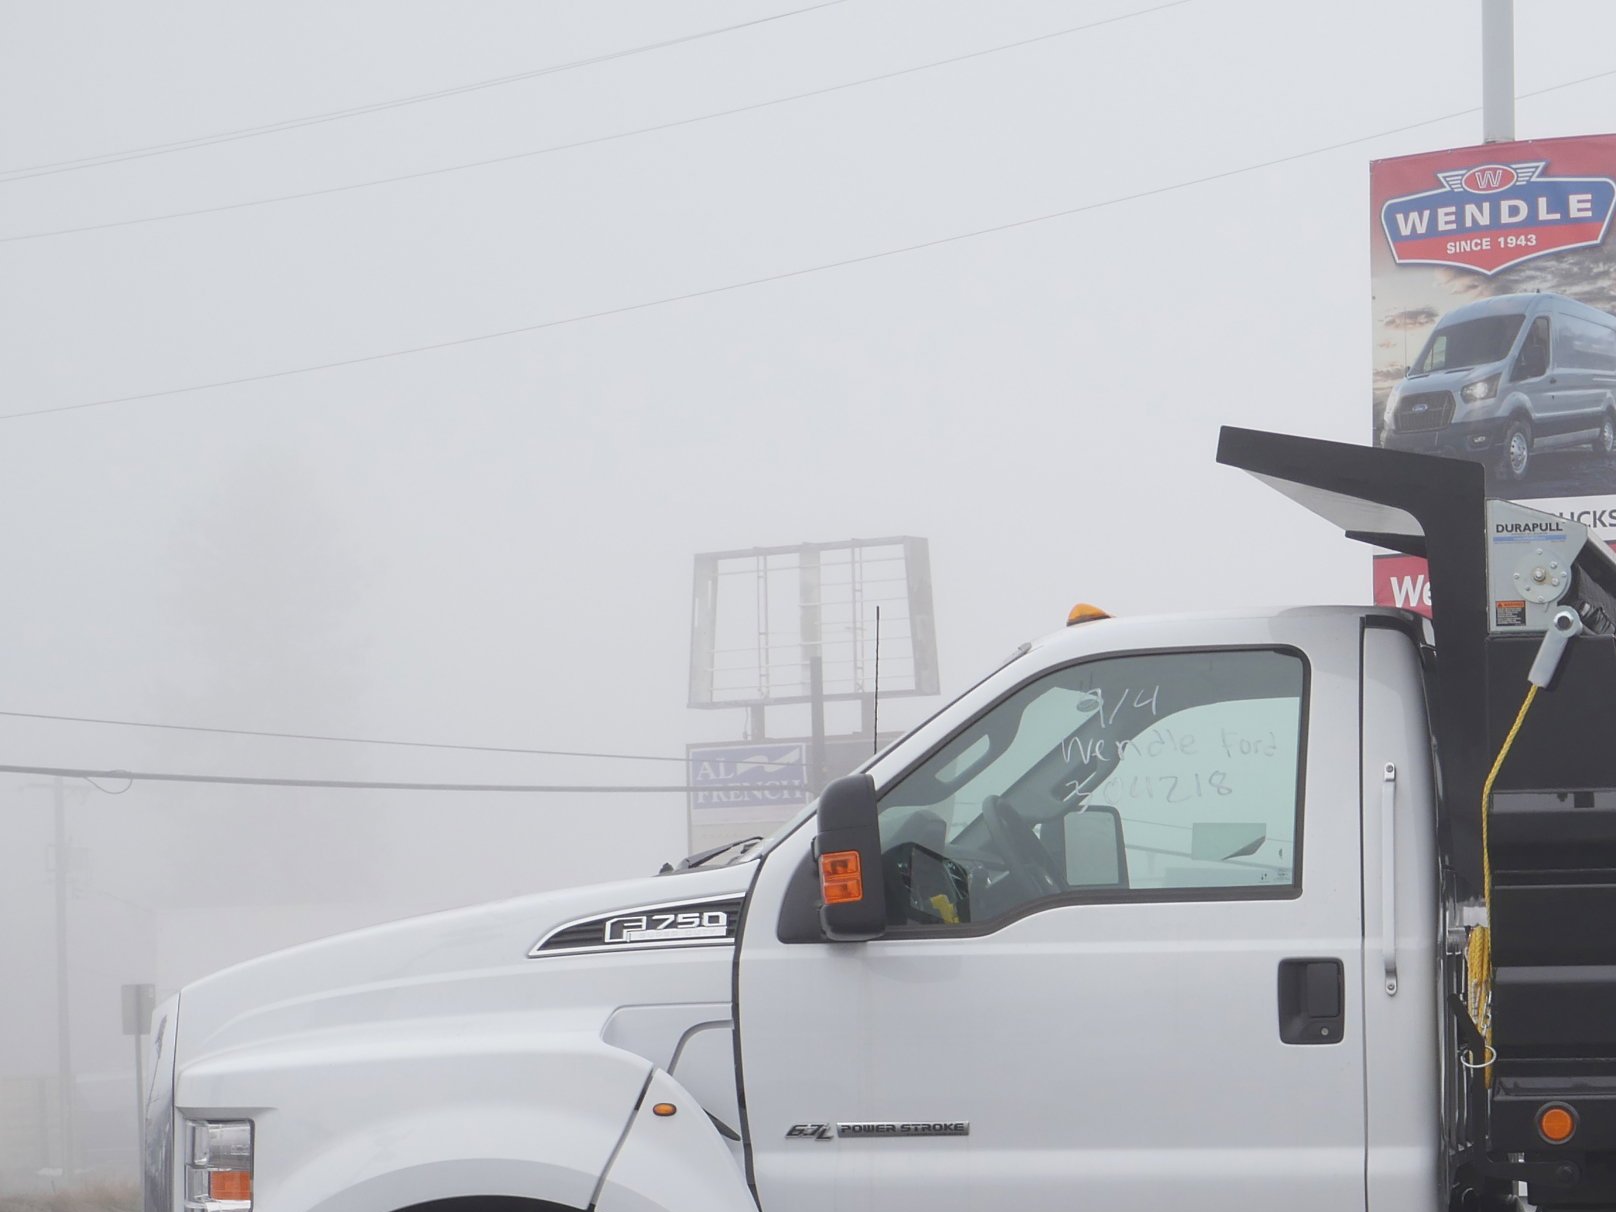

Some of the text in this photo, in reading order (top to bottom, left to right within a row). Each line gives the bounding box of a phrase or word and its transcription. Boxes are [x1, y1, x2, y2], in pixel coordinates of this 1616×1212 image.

[1475, 170, 1502, 189] W
[1395, 194, 1593, 236] WENDLE
[1446, 235, 1537, 254] SINCE 1943
[1495, 522, 1563, 534] DURAPULL
[1061, 729, 1198, 764] Wendle
[696, 758, 735, 780] AL
[696, 779, 803, 804] FRENCH
[840, 1124, 896, 1133] POWER
[900, 1123, 965, 1132] STROKE
